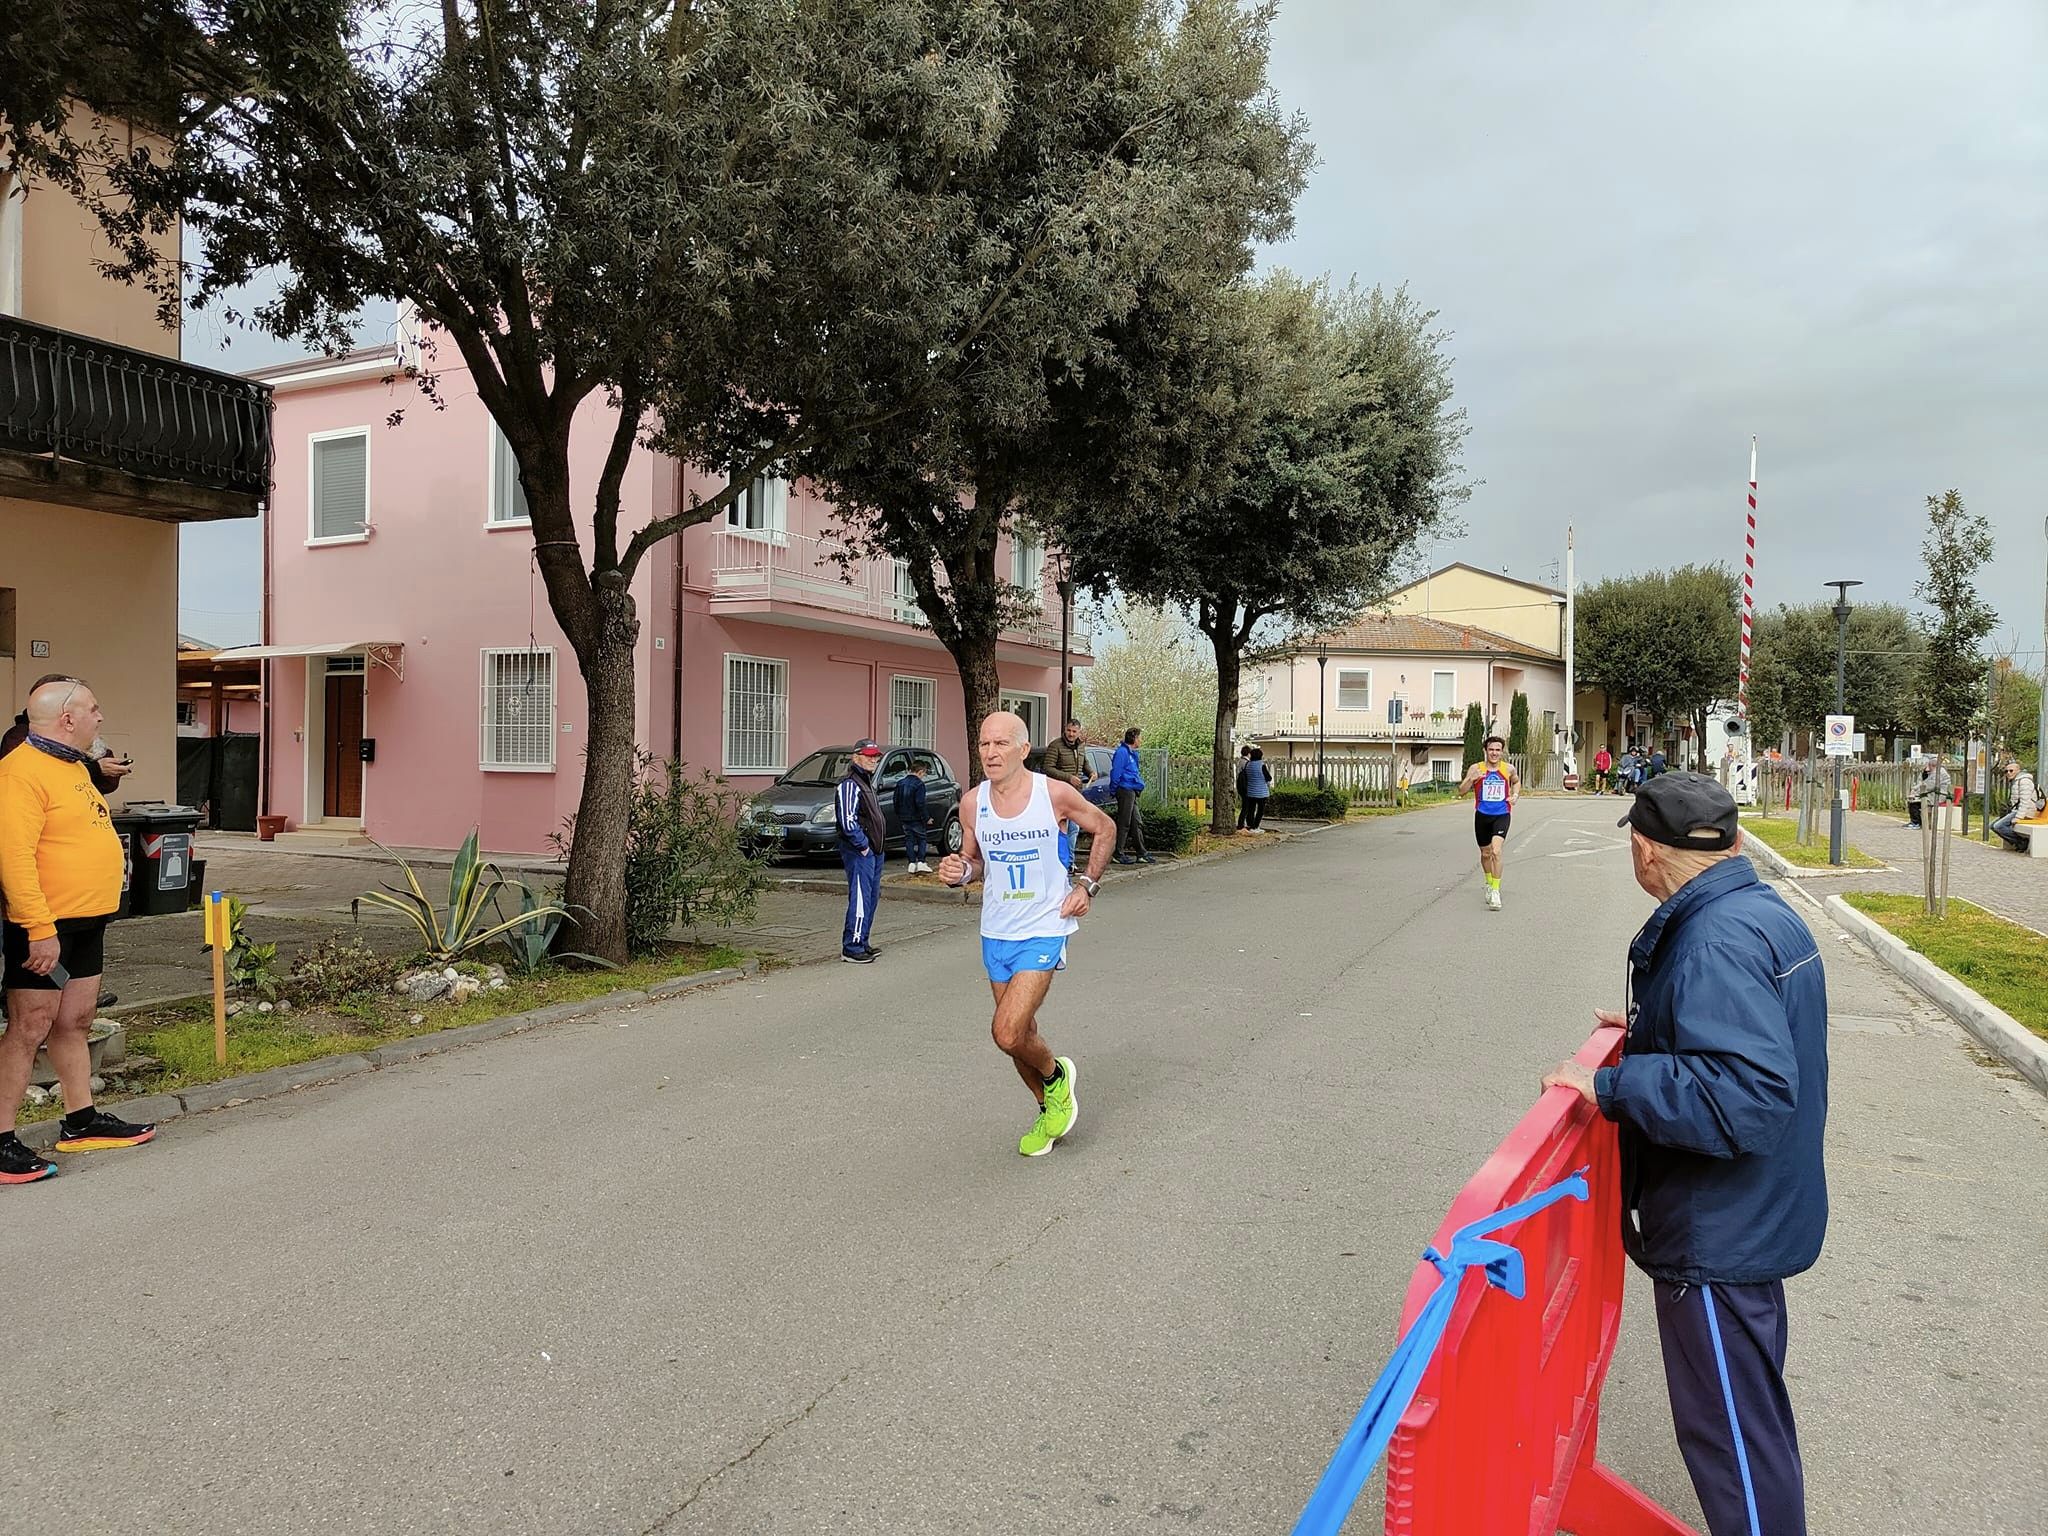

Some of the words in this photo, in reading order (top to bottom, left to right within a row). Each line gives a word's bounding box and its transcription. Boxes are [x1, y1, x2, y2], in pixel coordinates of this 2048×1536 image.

[1487, 785, 1501, 796] 274
[981, 828, 1050, 846] lughesina
[1006, 863, 1026, 891] 17
